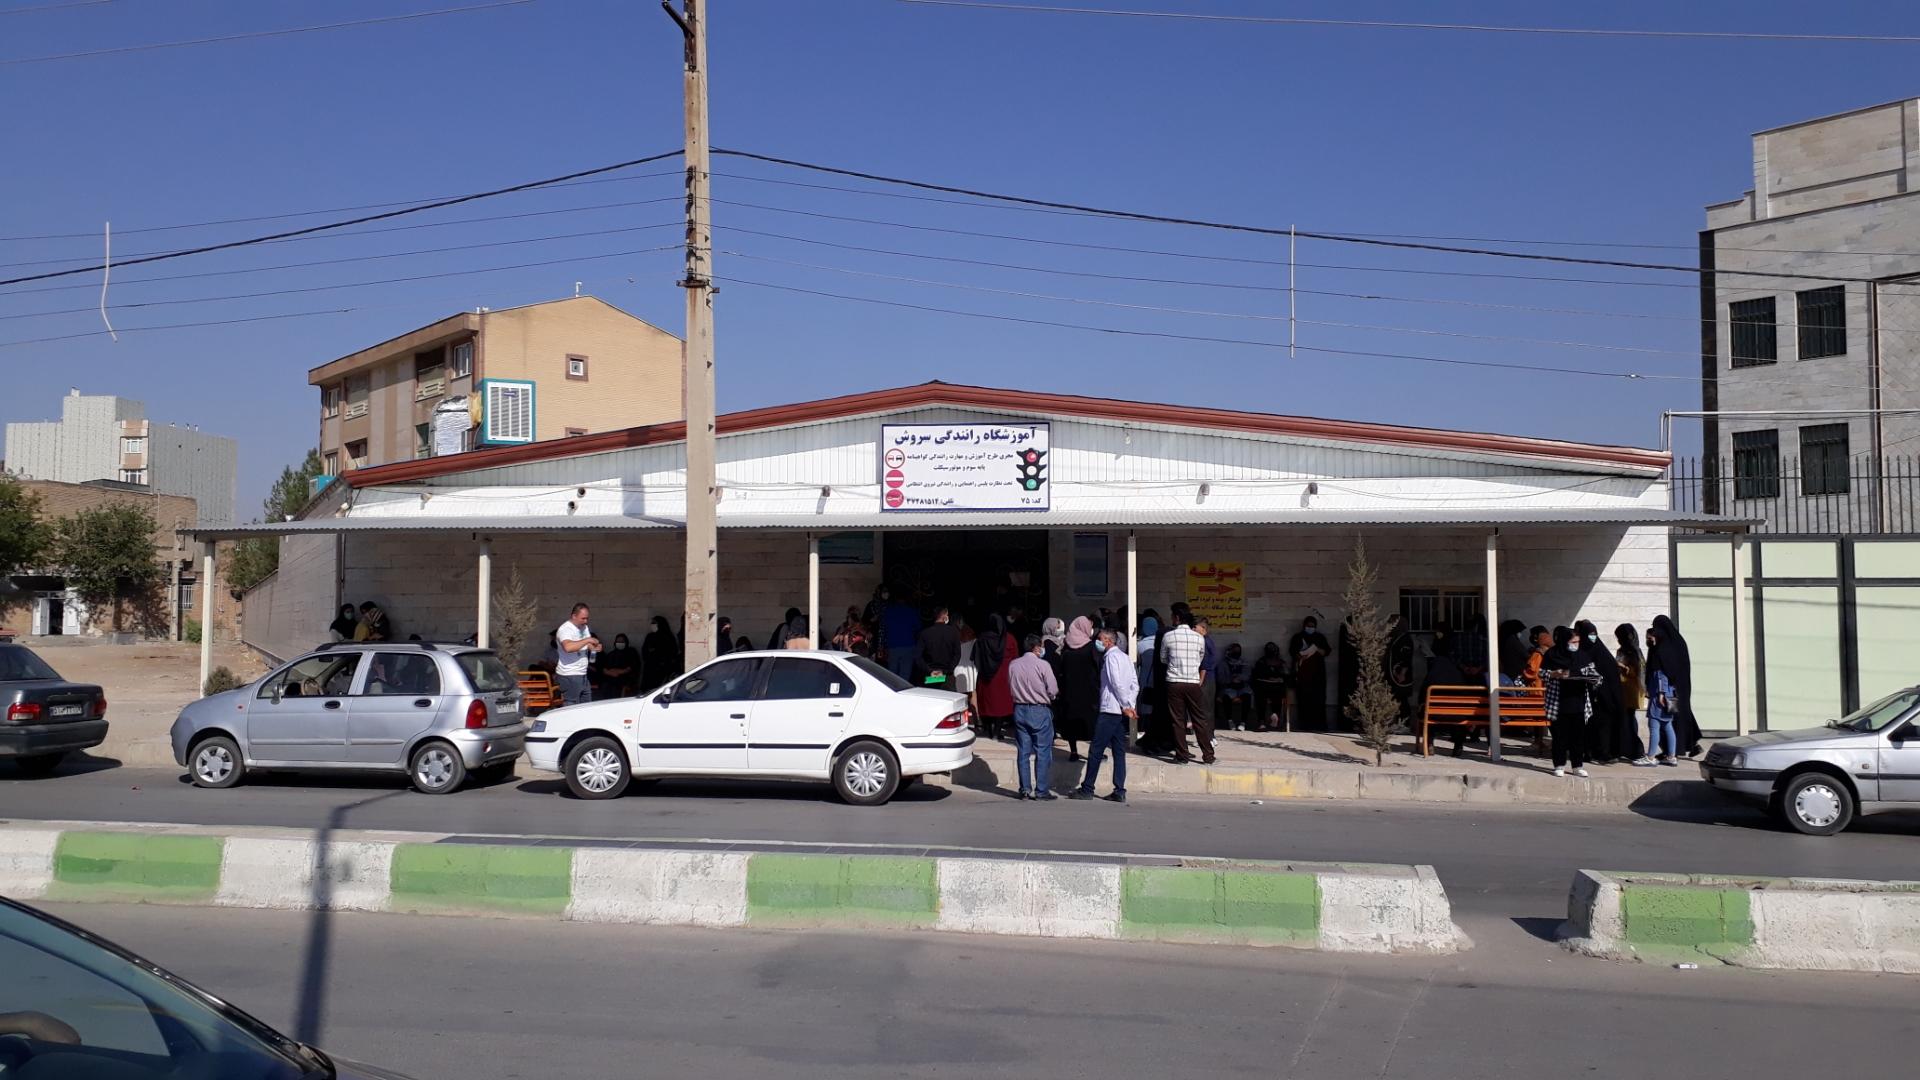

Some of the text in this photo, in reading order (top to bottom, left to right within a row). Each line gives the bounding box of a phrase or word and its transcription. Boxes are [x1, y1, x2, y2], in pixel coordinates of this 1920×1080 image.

[894, 426, 1037, 445] آموزشگاه رانندگی سروش
[968, 453, 986, 461] آموزش
[999, 453, 1014, 461] مجری
[905, 481, 923, 489] انتظامی
[957, 480, 977, 488] راهنمایی
[1189, 563, 1242, 582] بوفه
